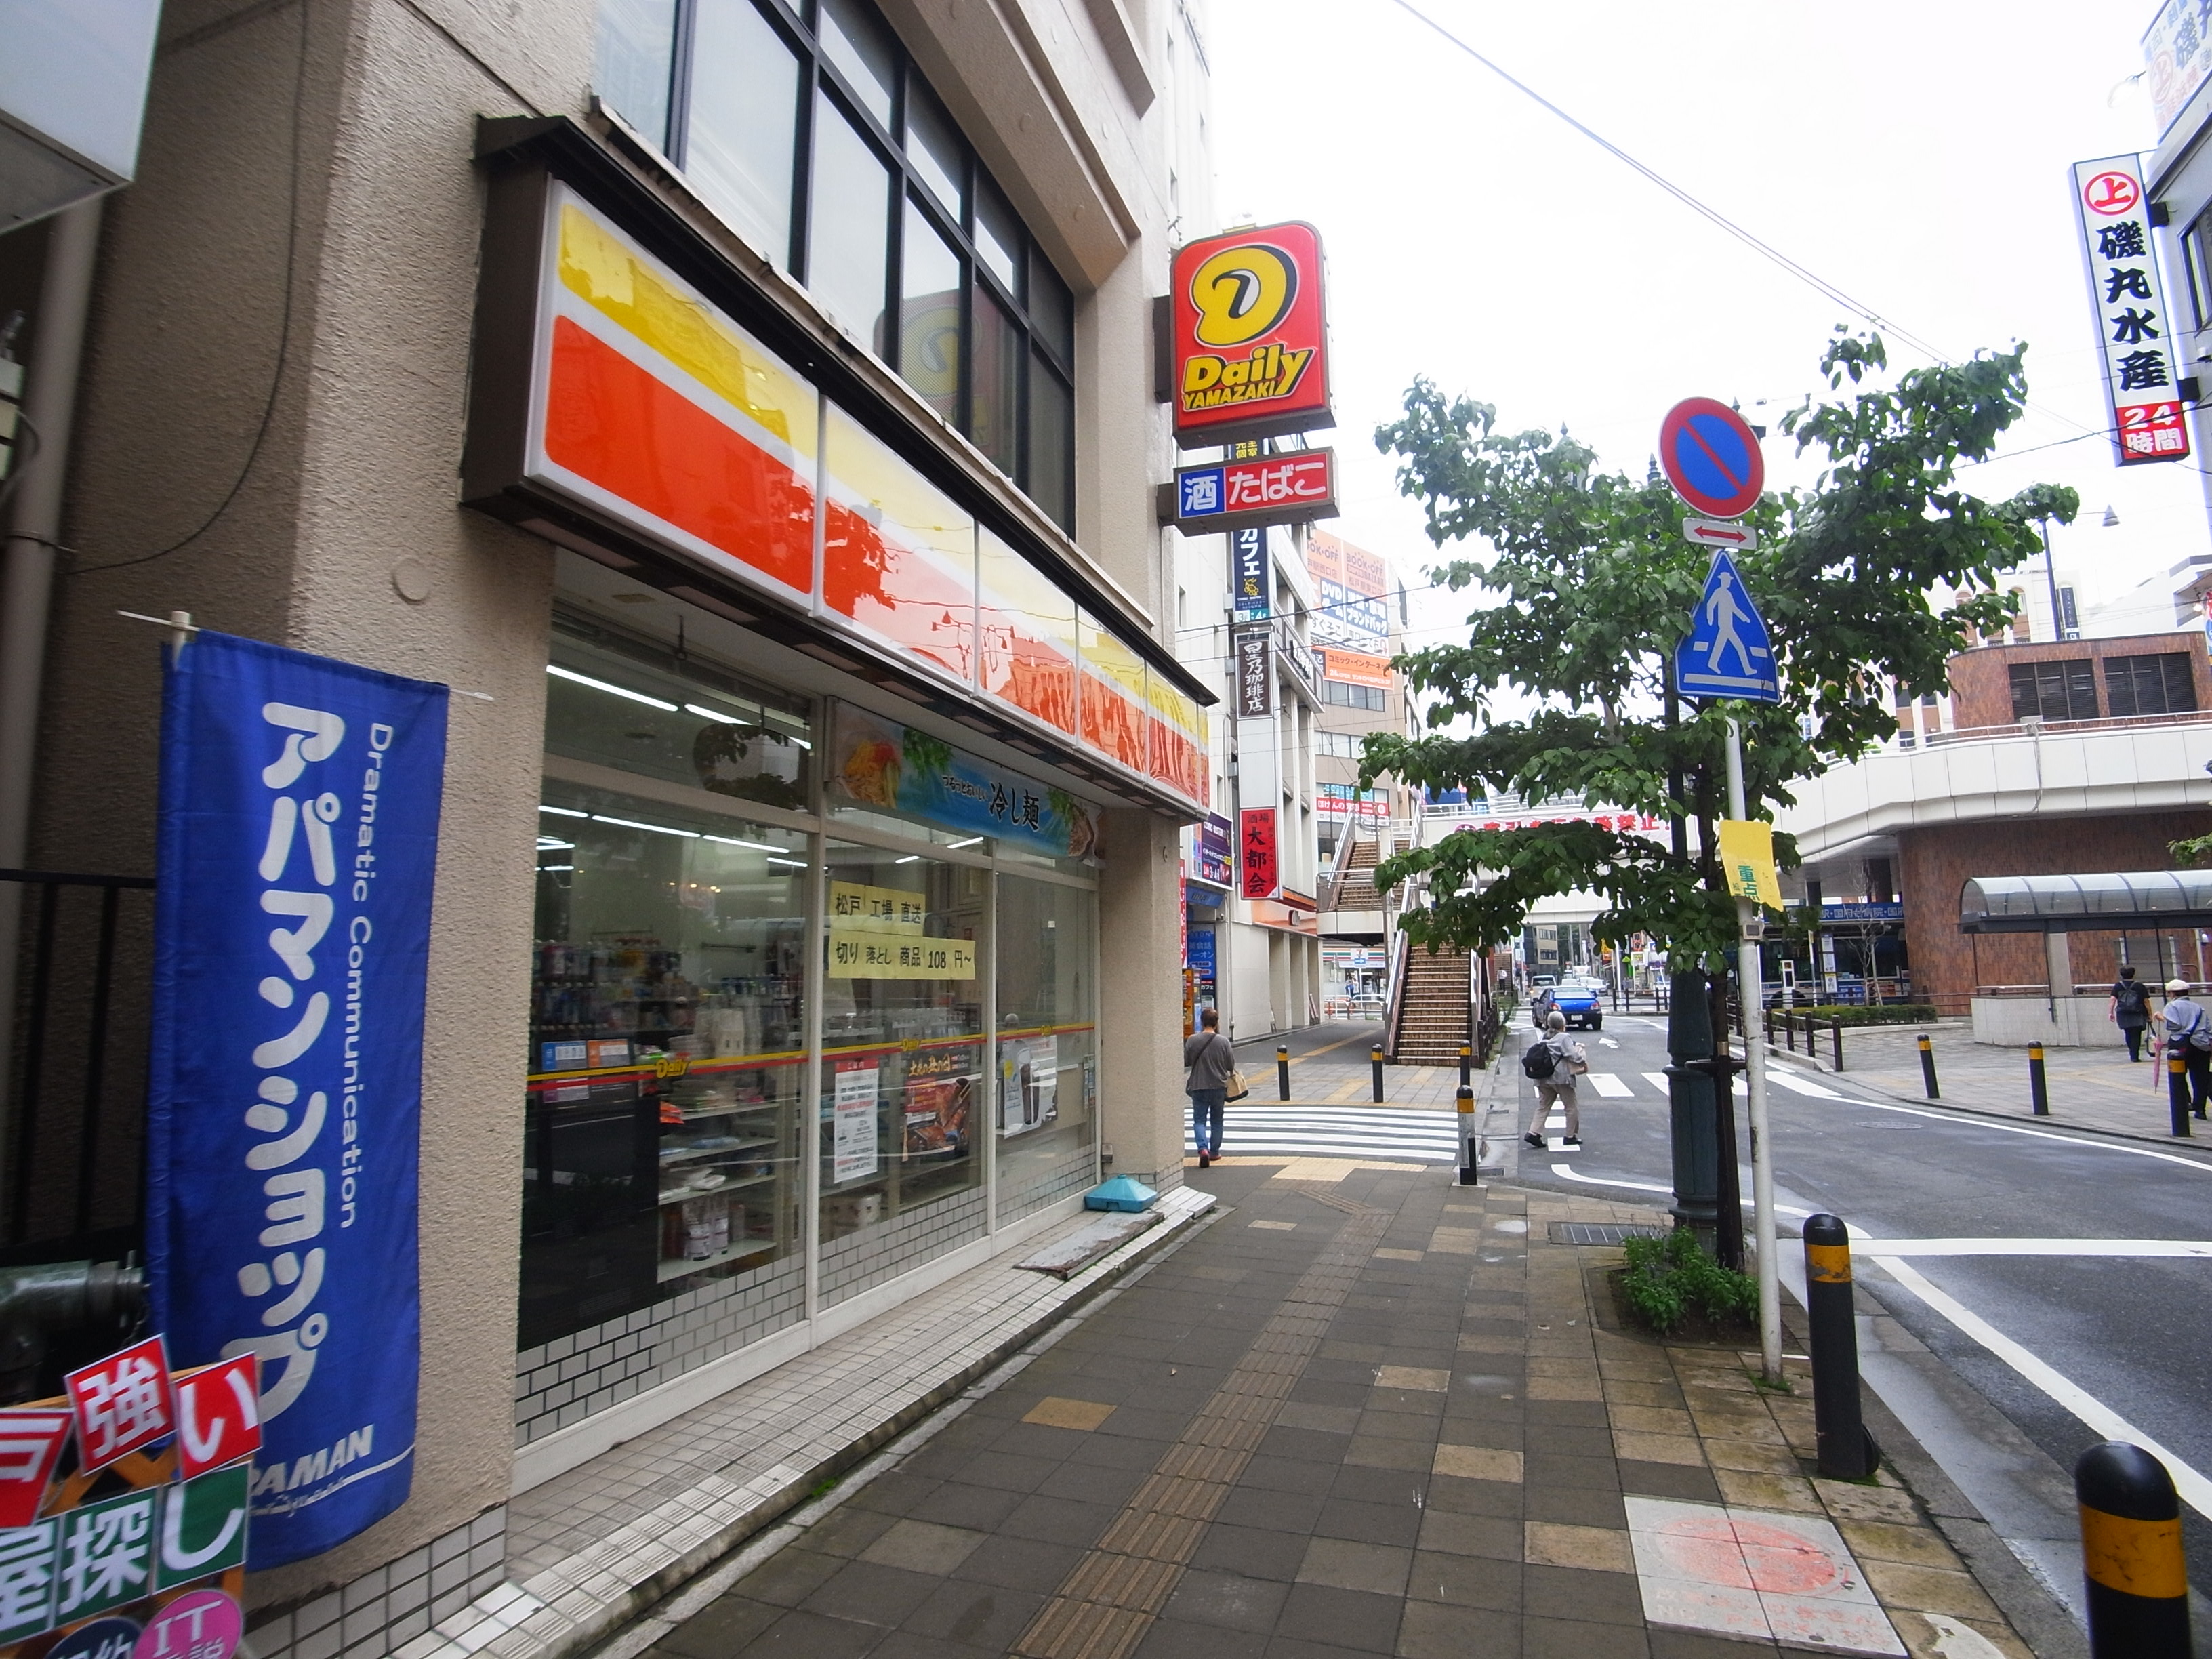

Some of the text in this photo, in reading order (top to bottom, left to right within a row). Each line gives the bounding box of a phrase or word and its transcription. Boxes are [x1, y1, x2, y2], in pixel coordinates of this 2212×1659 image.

[2096, 221, 2169, 391] 磯丸水産
[1183, 344, 1311, 394] Daily
[1183, 381, 1275, 409] YAMAZAKI
[2123, 406, 2177, 431] 24
[2125, 428, 2182, 455] 時間
[1184, 474, 1218, 512] 酒
[1229, 462, 1325, 505] たばこ
[1240, 529, 1261, 576] カフェ
[1322, 581, 1343, 600] DVD
[1244, 642, 1264, 715] 星乃珈琲店
[1329, 655, 1386, 670] コミック・インターネ
[989, 783, 1040, 831] 冷し麺
[1246, 826, 1267, 893] 大都会
[835, 893, 922, 925] 松戸 工場 直送
[341, 722, 394, 1228] Dramatic Communication
[836, 942, 859, 965] 切り
[866, 946, 892, 966] 落とし
[900, 947, 922, 968] 商品
[928, 951, 947, 970] 108
